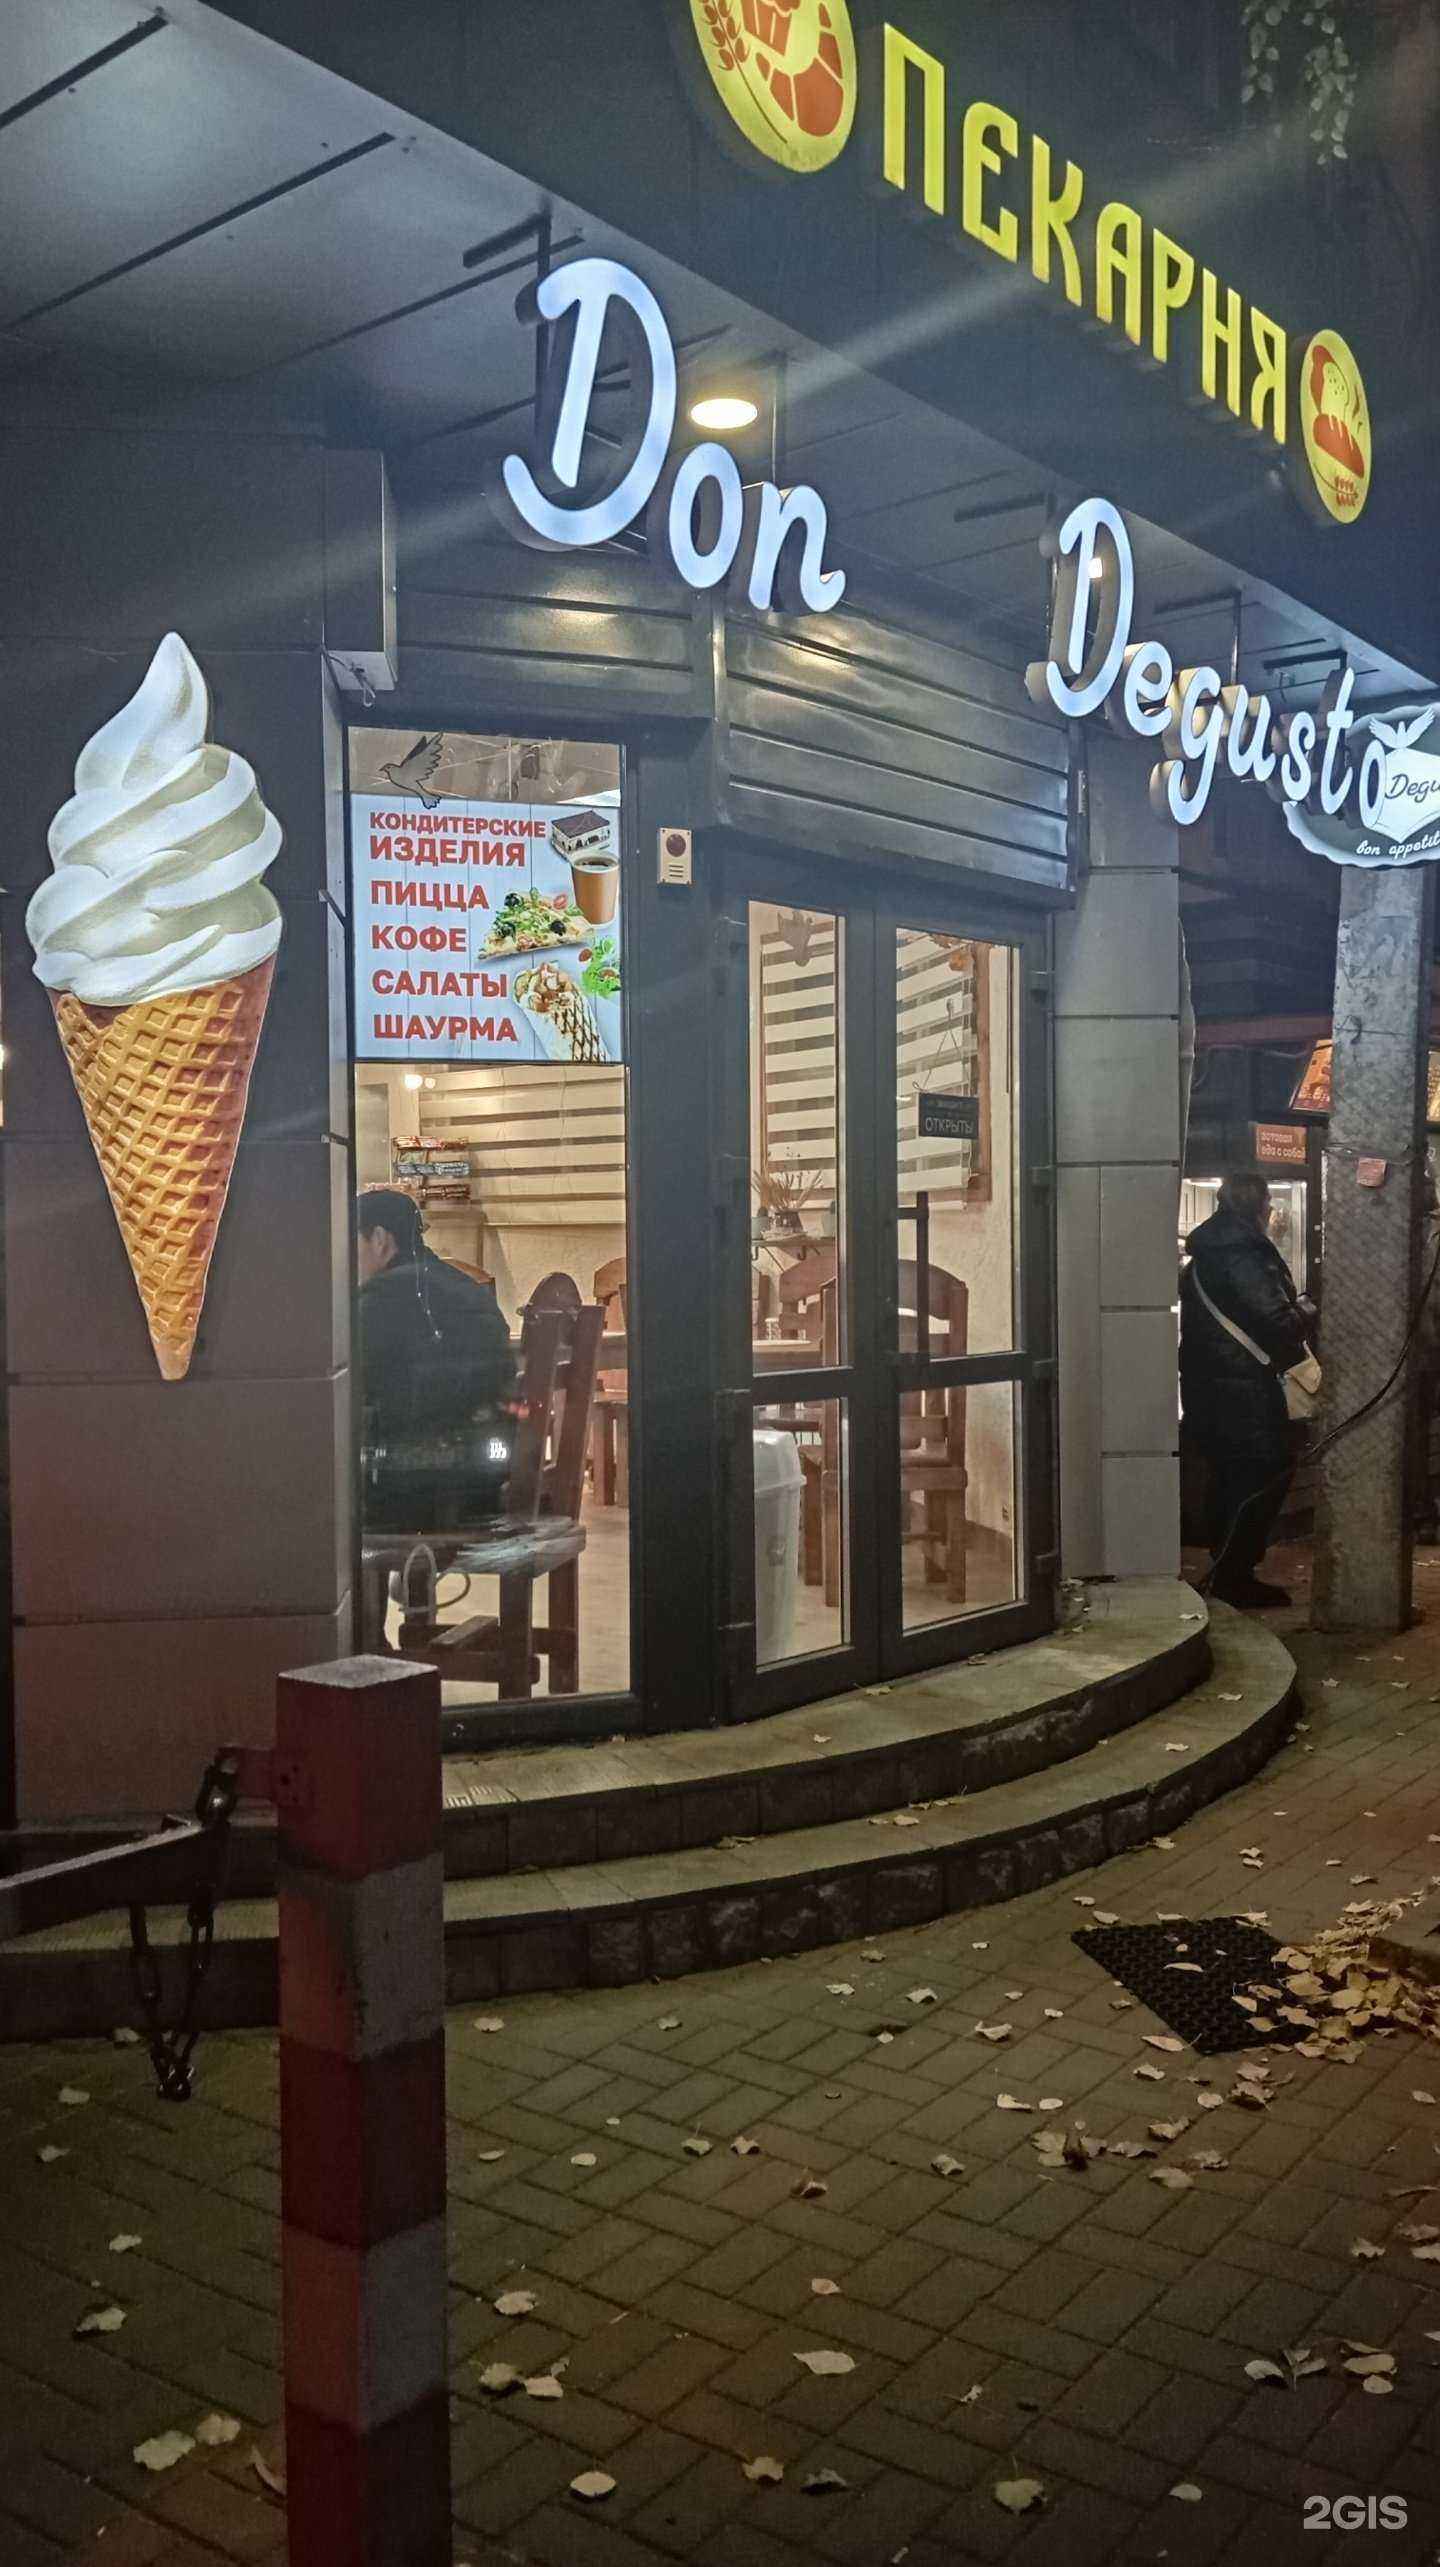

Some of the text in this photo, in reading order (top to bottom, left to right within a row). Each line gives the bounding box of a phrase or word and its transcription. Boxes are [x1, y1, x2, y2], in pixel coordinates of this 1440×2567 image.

[883, 23, 1286, 445] ПЕКАРНЯ
[502, 257, 1386, 829] Don Degusto
[369, 811, 546, 838] КОНДИТЕРСКИЕ
[369, 835, 526, 867] ИЗДЕЛИЯ
[1356, 840, 1381, 855] bon
[370, 880, 489, 912] ПИЦЦА
[371, 925, 467, 952] КОФЕ
[372, 969, 507, 997] САЛАТЫ
[373, 1014, 519, 1041] ШАУРМА
